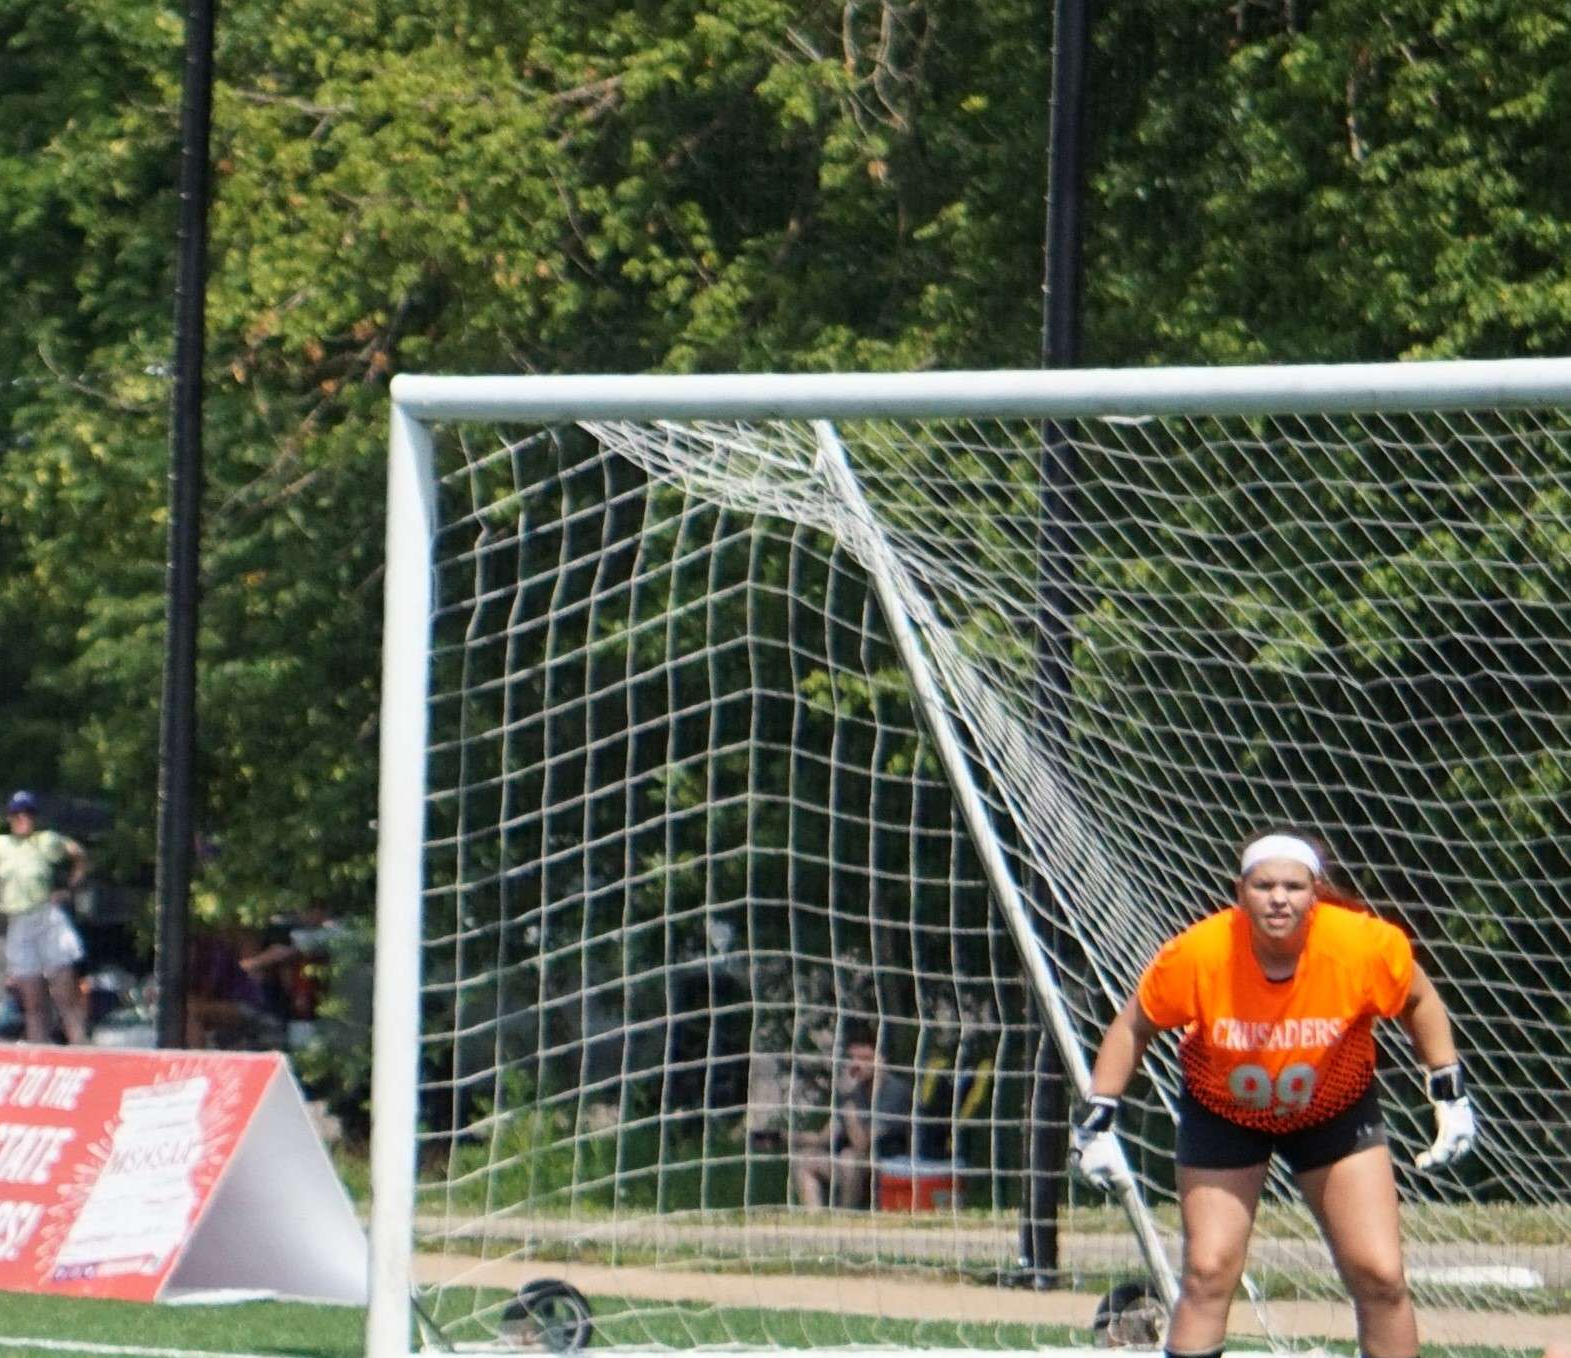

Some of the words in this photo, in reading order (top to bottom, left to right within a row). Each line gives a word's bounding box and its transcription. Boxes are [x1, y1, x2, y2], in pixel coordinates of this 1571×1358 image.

[1213, 1017, 1343, 1051] CRUSADERS
[10, 1064, 51, 1108] TO
[39, 1066, 94, 1111] THE
[1229, 1062, 1315, 1115] 99
